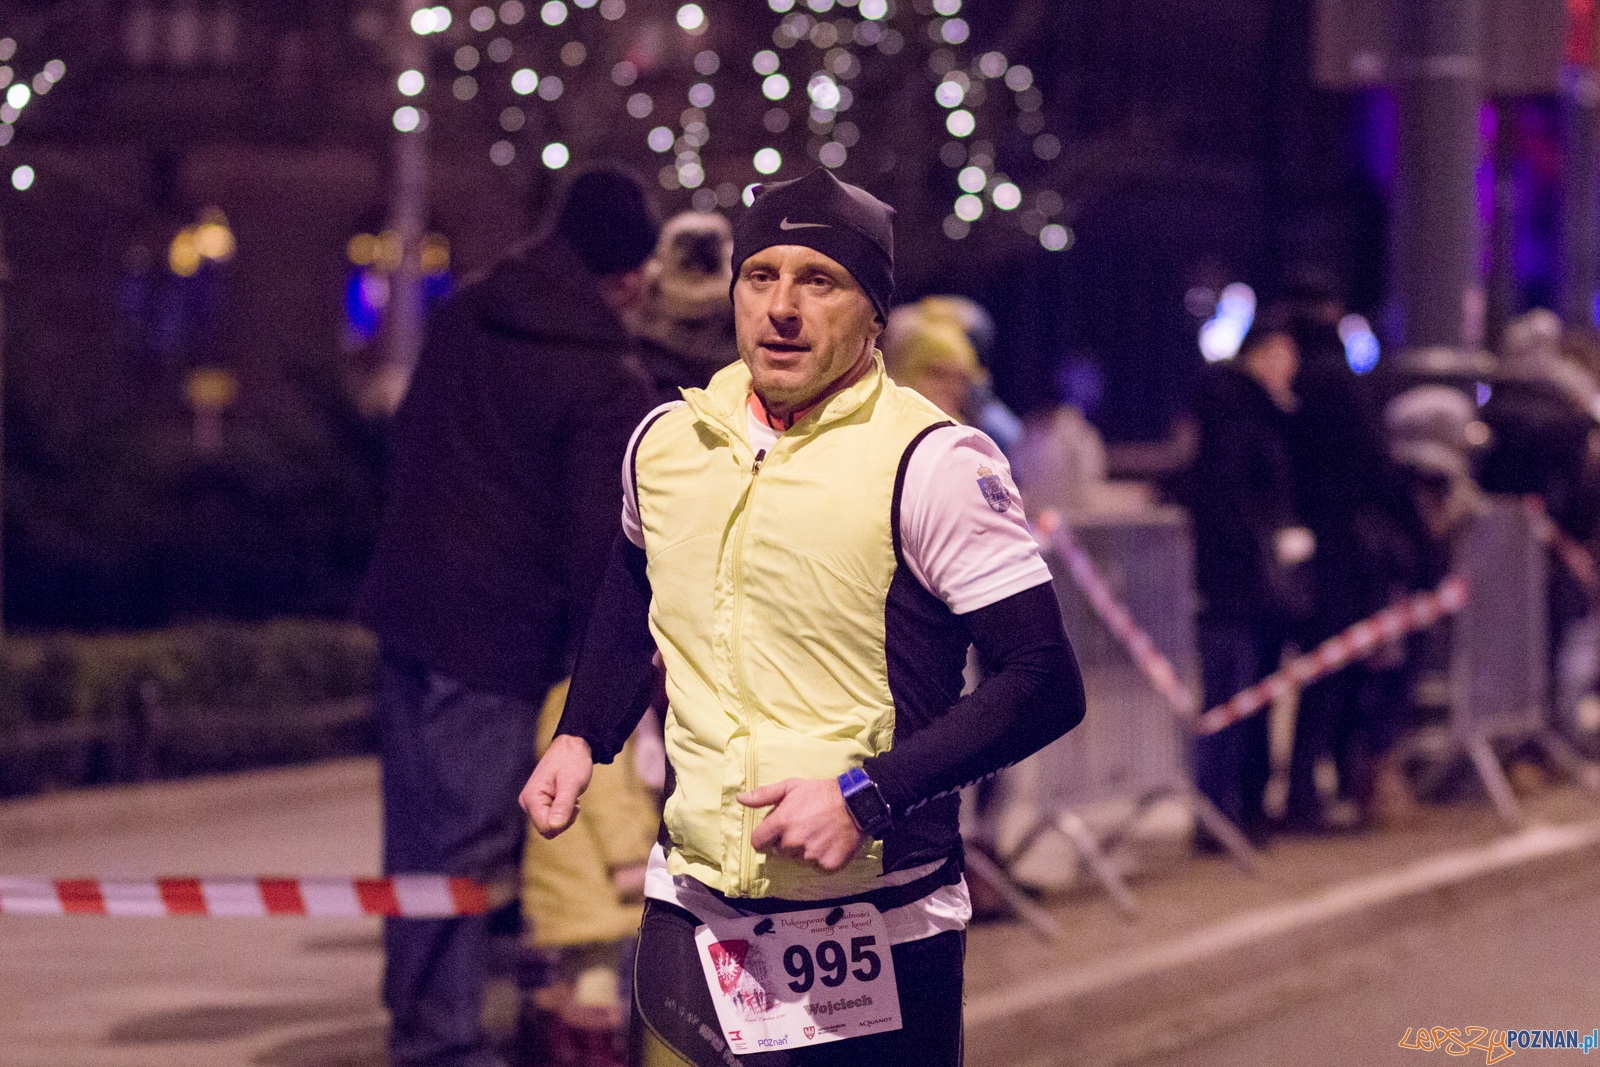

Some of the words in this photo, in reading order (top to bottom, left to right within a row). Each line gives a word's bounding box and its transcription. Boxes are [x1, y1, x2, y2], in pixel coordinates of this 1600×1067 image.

[781, 916, 827, 930] Pokonywan
[837, 923, 849, 931] we
[783, 935, 882, 994] 995
[803, 994, 874, 1016] Wojciech
